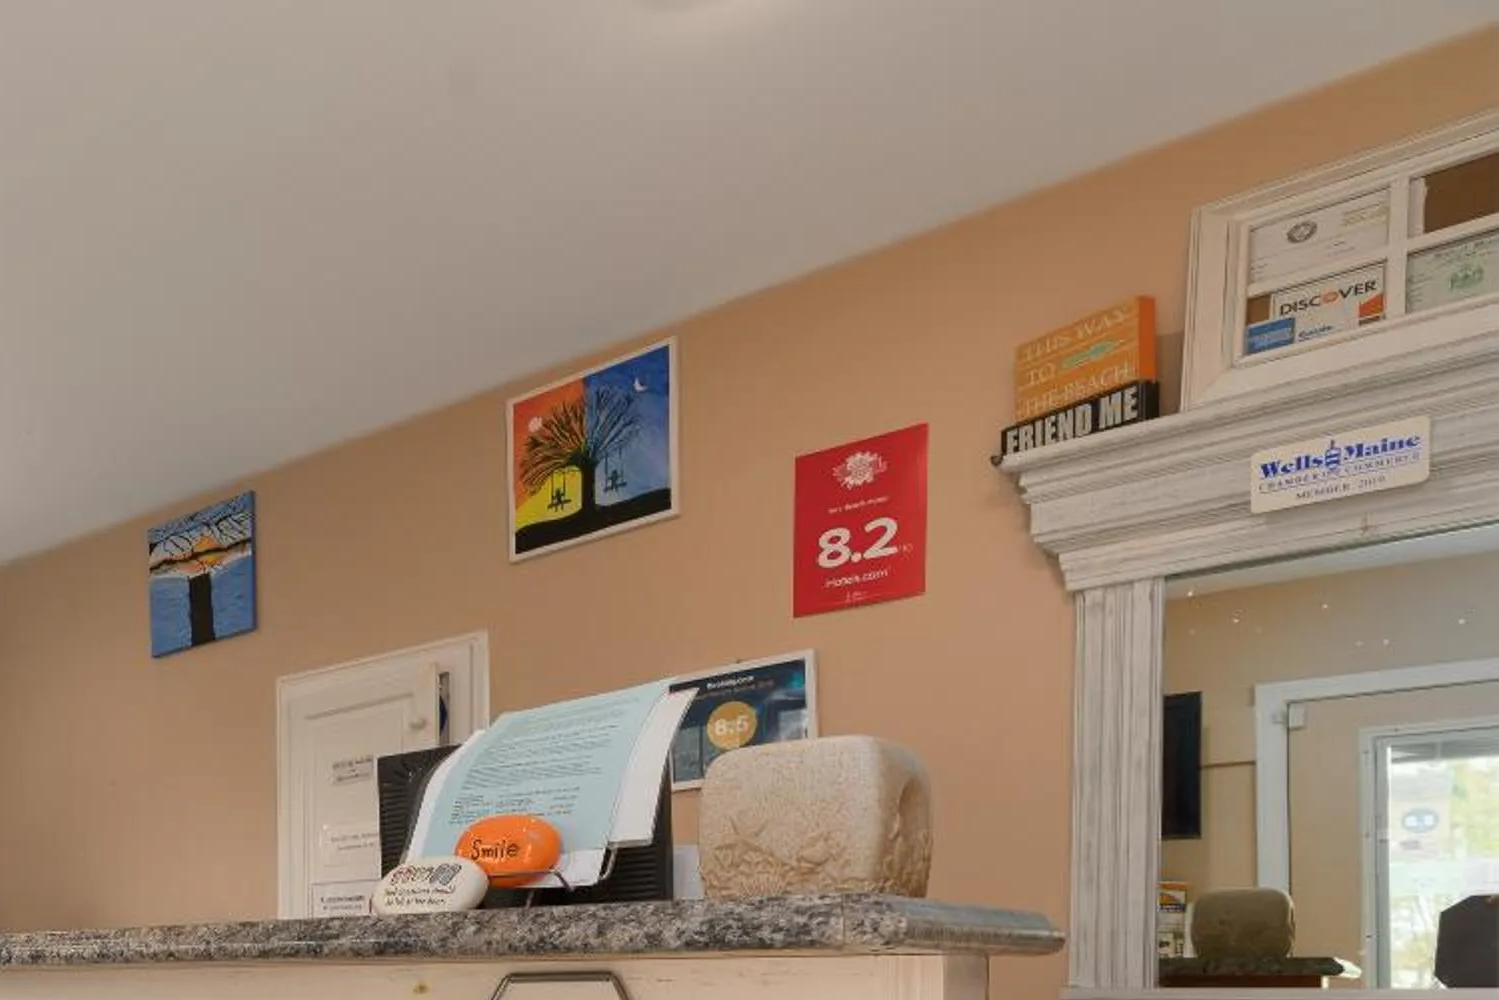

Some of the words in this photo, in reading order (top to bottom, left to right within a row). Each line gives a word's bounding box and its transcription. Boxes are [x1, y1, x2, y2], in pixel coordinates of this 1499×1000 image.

[1279, 281, 1377, 316] DISCOVER
[1025, 334, 1072, 361] THIS
[1029, 362, 1057, 386] TO
[1005, 403, 1093, 456] FRIEND
[1100, 385, 1139, 430] ME
[1260, 454, 1324, 479] Wells
[1343, 435, 1421, 461] Maine
[817, 517, 898, 568] 8.2
[470, 838, 520, 861] Smile
